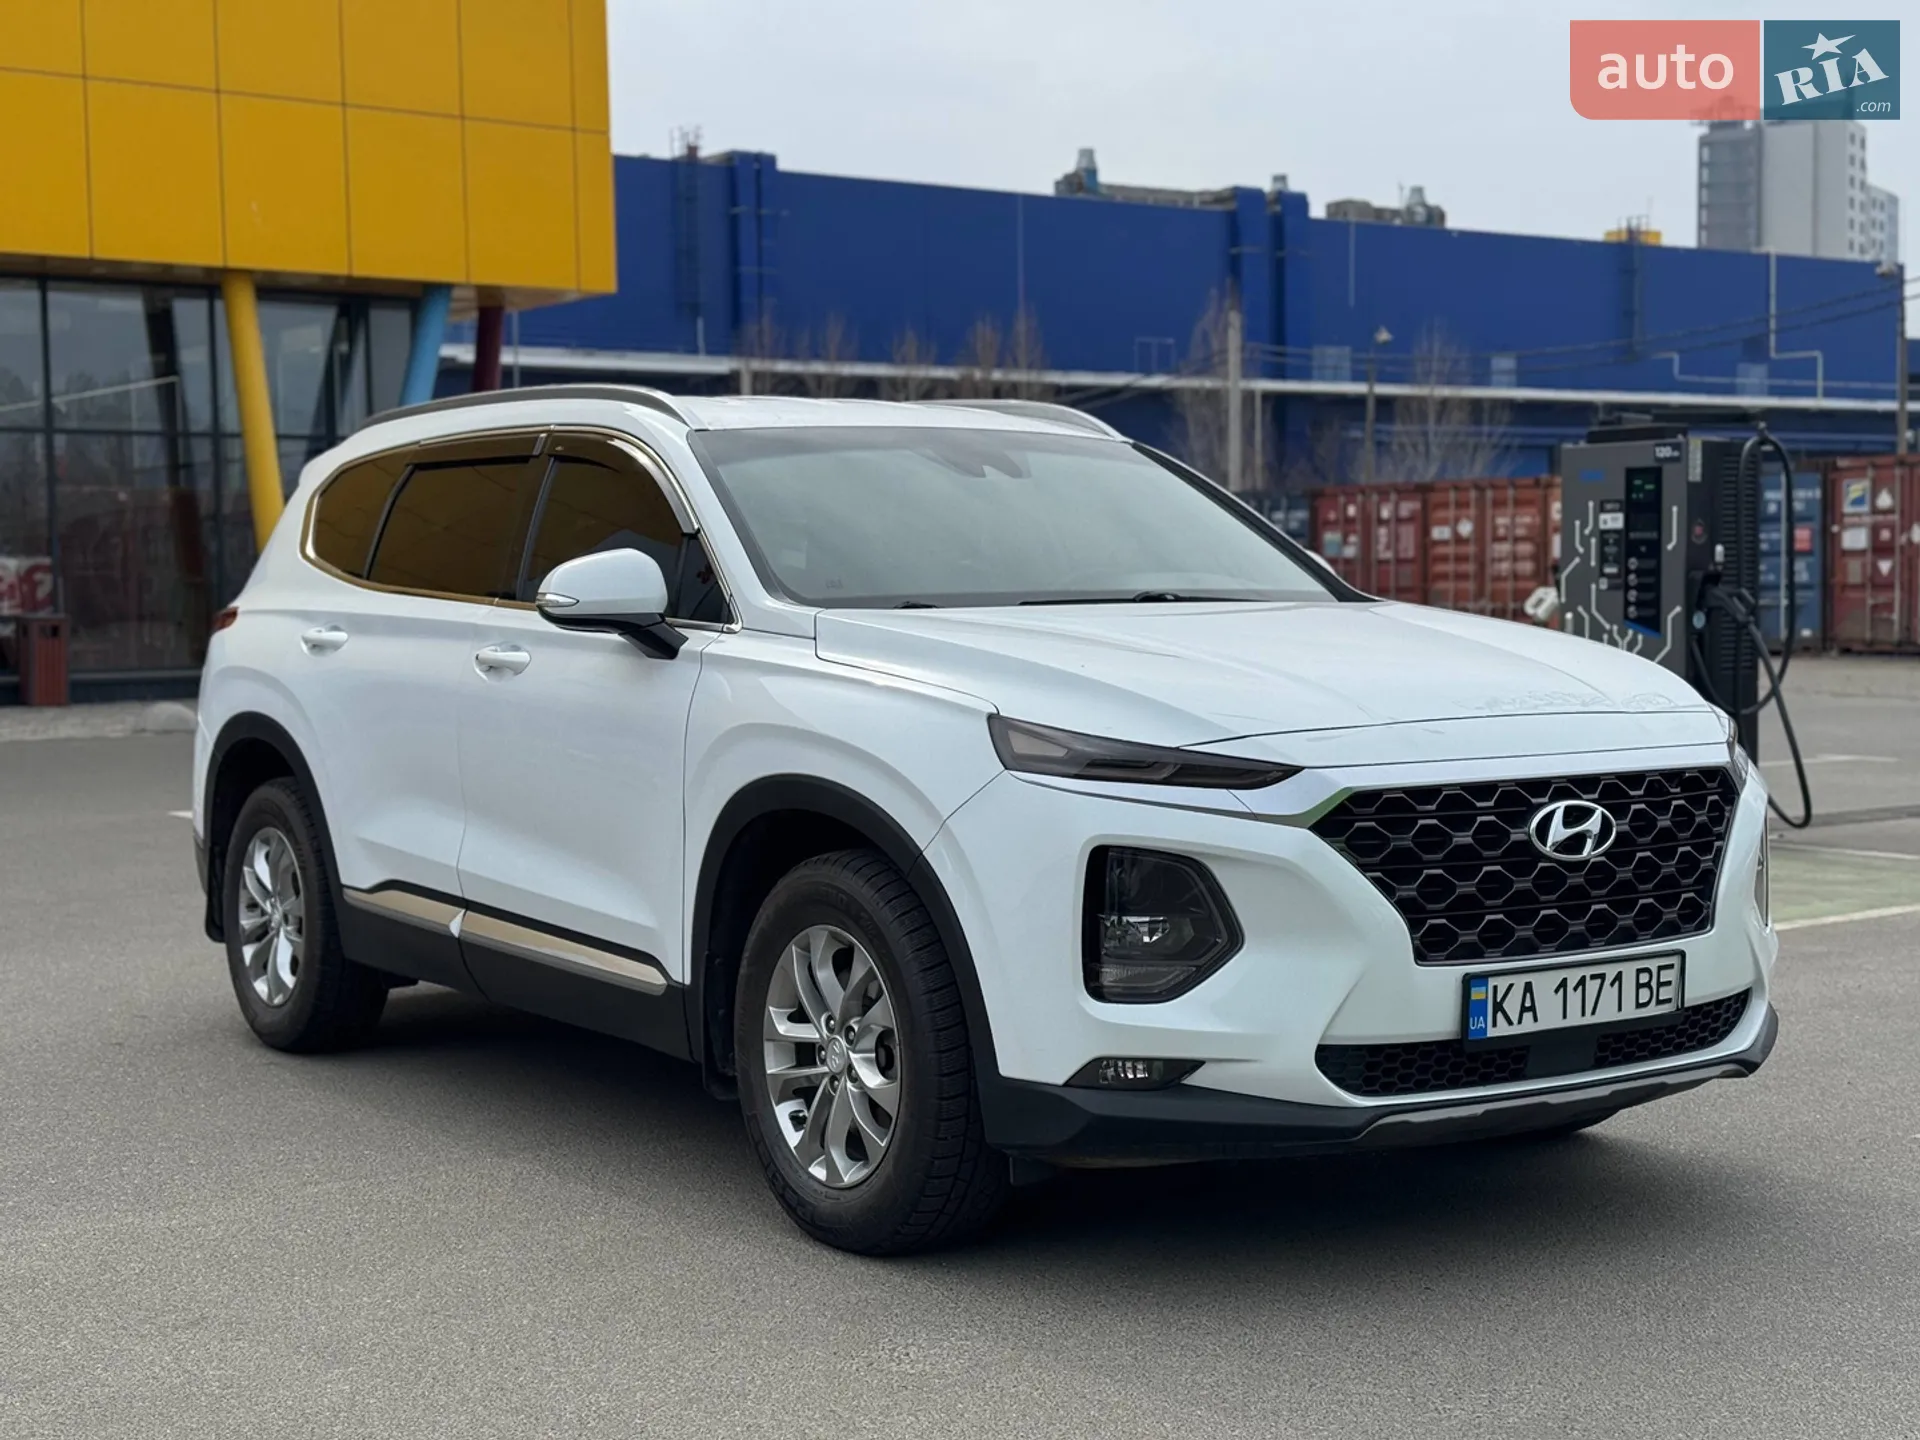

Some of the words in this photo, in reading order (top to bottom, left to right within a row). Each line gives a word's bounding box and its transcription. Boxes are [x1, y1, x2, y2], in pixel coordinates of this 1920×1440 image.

[1492, 981, 1538, 1028] KA
[1554, 970, 1623, 1020] 1171
[1635, 963, 1675, 1009] BE
[1470, 1015, 1486, 1030] UA
